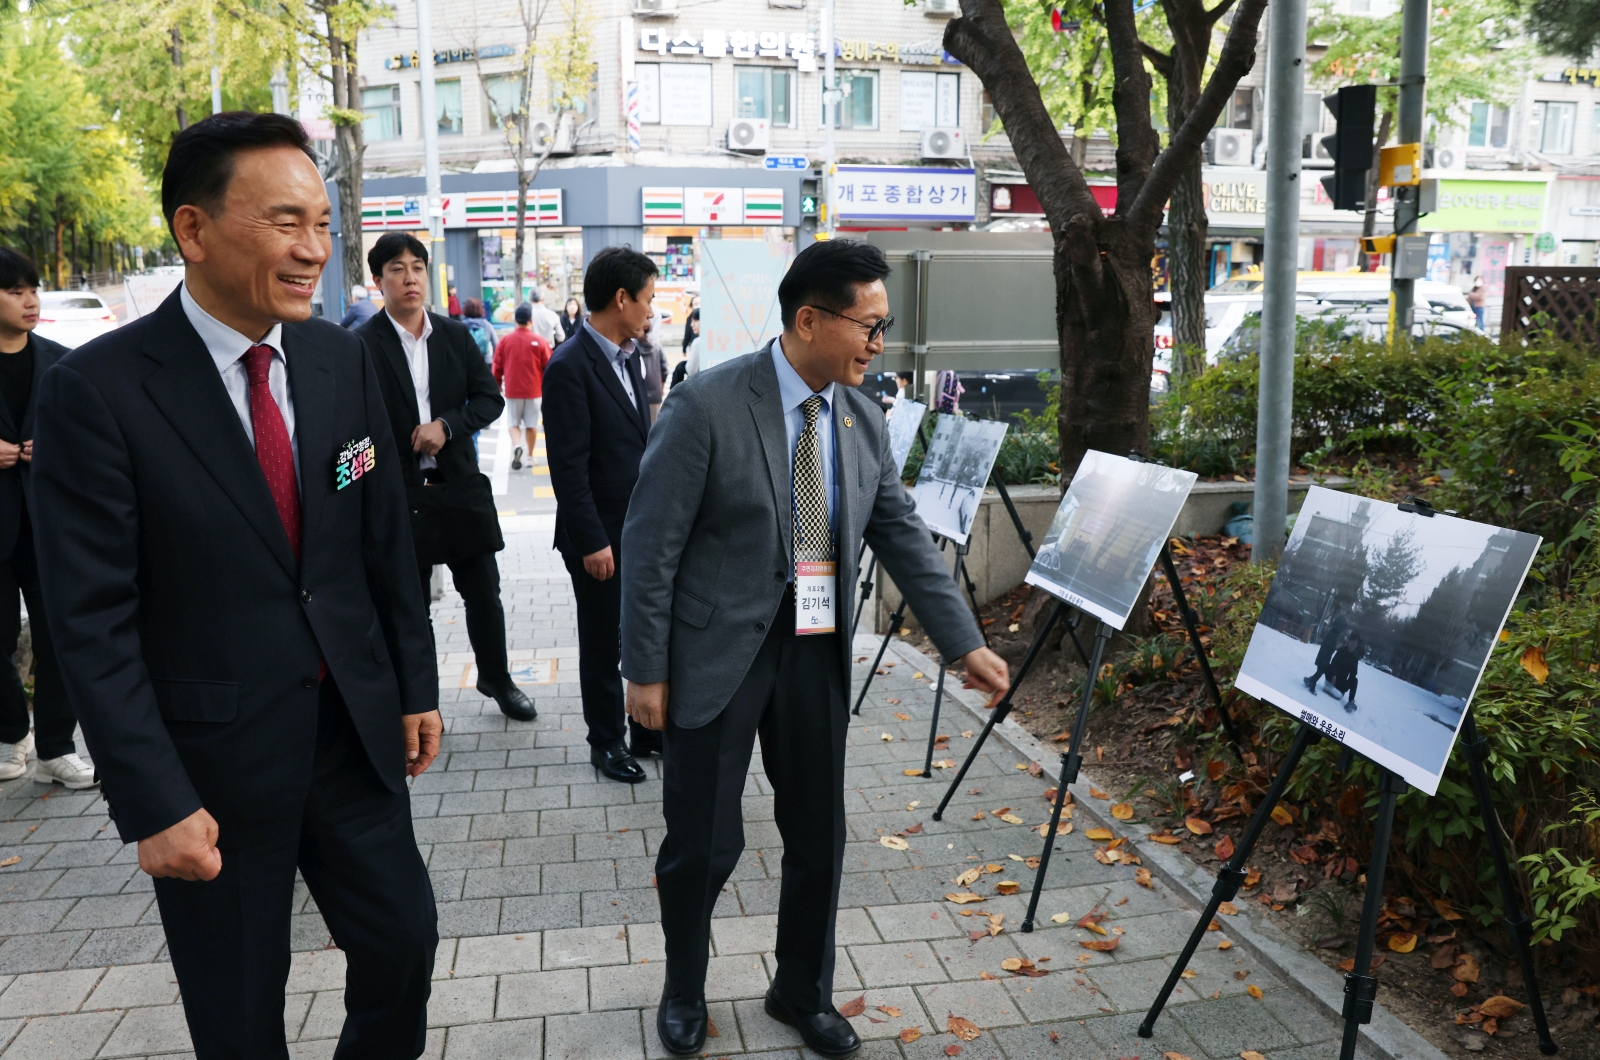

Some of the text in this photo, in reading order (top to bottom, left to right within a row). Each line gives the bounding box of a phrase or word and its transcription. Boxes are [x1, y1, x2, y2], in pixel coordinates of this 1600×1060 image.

[838, 184, 967, 205] 개포종합상가
[1211, 182, 1256, 198] OLIVE
[1210, 197, 1266, 214] CHICKE
[340, 436, 371, 464] 강남구청장
[336, 445, 375, 491] 조성명
[801, 596, 830, 610] 김기석
